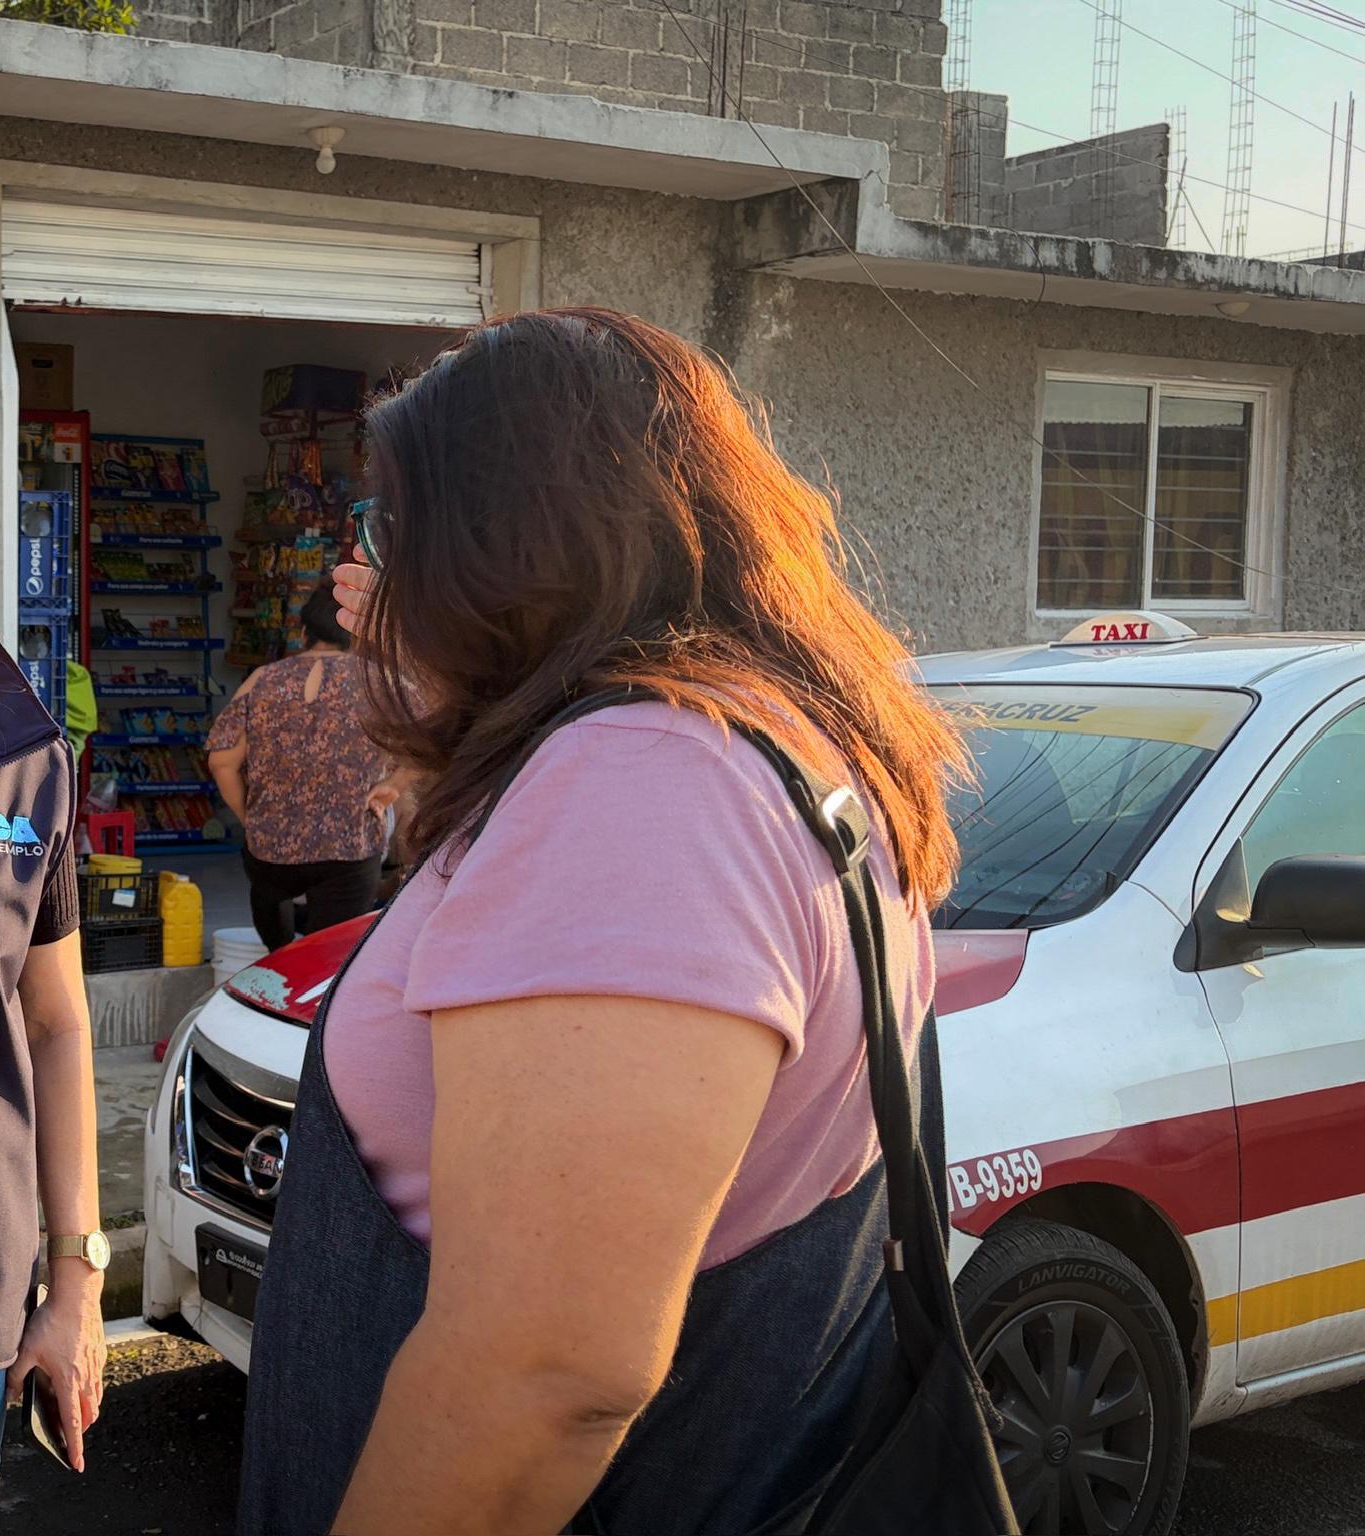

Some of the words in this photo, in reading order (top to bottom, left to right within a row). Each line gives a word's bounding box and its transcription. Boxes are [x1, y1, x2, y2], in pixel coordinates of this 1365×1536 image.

[28, 537, 42, 576] pepsi
[1091, 623, 1149, 642] TAXI
[1017, 1262, 1132, 1298] LANVIGATOR
